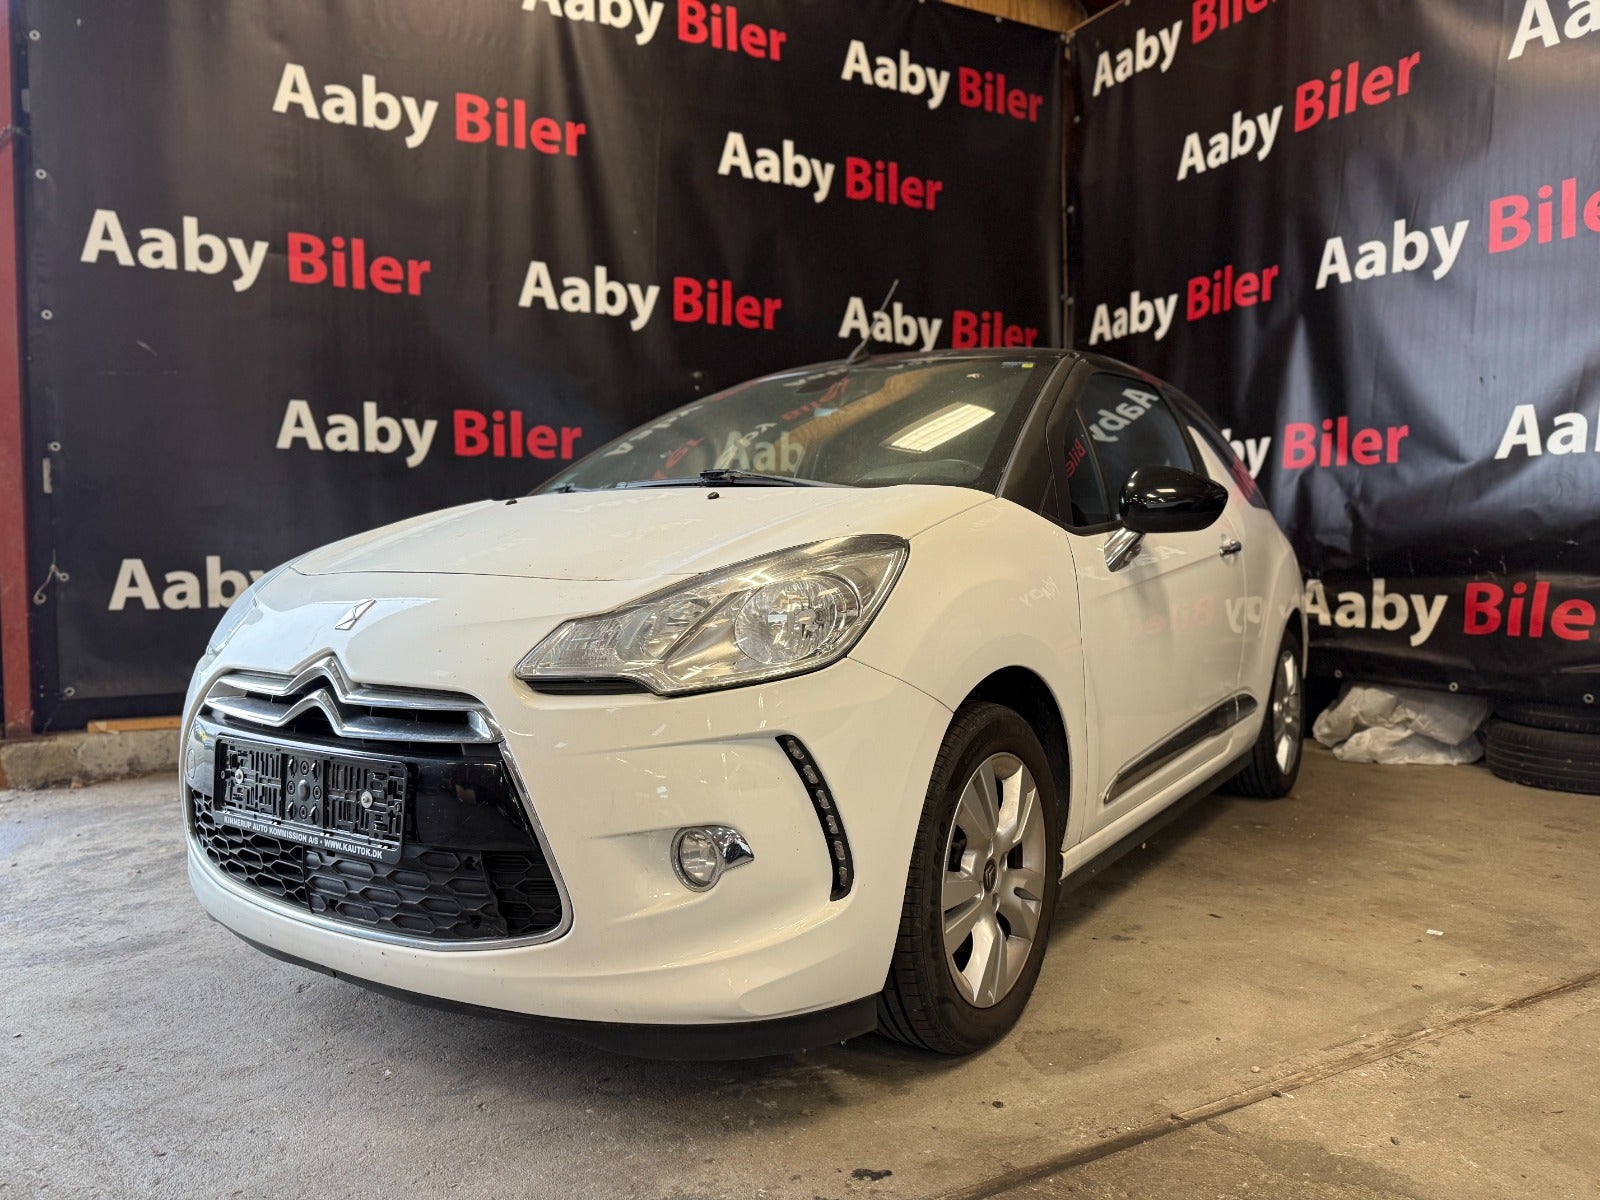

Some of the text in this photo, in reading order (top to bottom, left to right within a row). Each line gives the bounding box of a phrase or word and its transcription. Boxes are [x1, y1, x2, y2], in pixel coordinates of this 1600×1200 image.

[677, 0, 787, 61] Biler
[1092, 20, 1183, 97] Aaby
[272, 62, 587, 157] Aaby Biler
[841, 39, 1043, 122] Aaby Biler
[1177, 52, 1421, 181] Aaby Biler
[717, 131, 943, 210] Aaby Biler
[80, 209, 431, 296] Aaby Biler
[1316, 219, 1470, 289] Aaby
[518, 260, 783, 331] Aaby Biler
[838, 296, 1038, 352] Aaby Biler
[1089, 265, 1279, 346] Aaby Biler
[276, 400, 438, 468] Aaby
[453, 409, 582, 460] Biler
[1282, 416, 1409, 470] Biler
[1494, 403, 1600, 460] Aa
[108, 555, 265, 611] Aab
[1305, 578, 1448, 647] Aaby
[1463, 581, 1600, 641] Bile
[252, 822, 268, 833] AUTO
[268, 826, 308, 843] KOMMISSION
[308, 835, 319, 845] A/S
[324, 839, 383, 860] WWW.KAUTOK.DK
